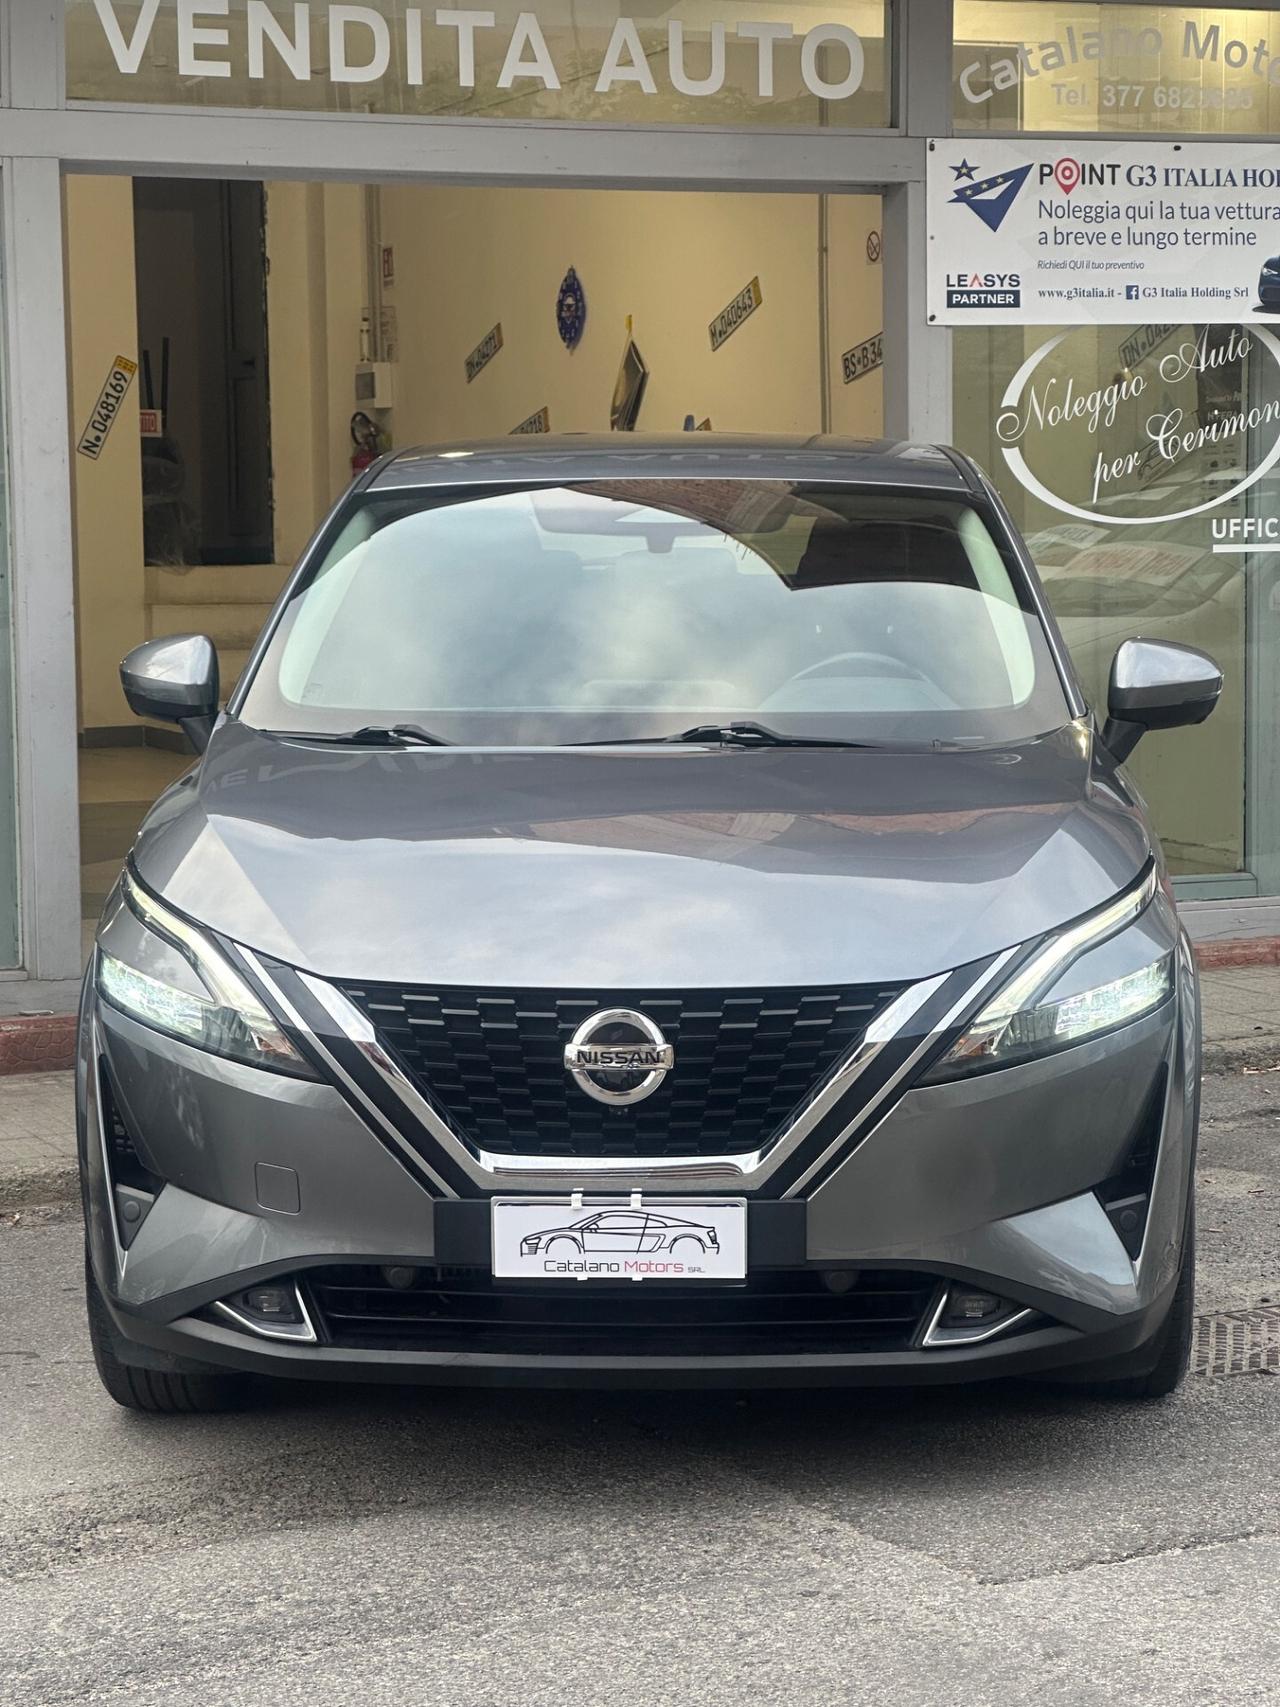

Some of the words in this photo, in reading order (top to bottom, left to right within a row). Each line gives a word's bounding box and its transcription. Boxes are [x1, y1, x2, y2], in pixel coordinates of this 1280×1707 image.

[89, 0, 562, 91] VENDITA
[594, 16, 865, 101] AUTO
[959, 25, 1164, 104] Catalano
[1103, 84, 1145, 108] 377
[1126, 164, 1157, 187] G3
[1164, 168, 1238, 187] ITALIA
[1038, 200, 1121, 223] Noleggia
[1126, 201, 1154, 223] qui
[1160, 201, 1175, 220] la
[1180, 205, 1210, 220] tua
[1215, 205, 1280, 221] vettura
[1038, 231, 1048, 245] a
[1054, 226, 1107, 246] breve
[1111, 231, 1122, 245] e
[1127, 227, 1179, 249] lungo
[1184, 227, 1257, 246] termine
[1037, 260, 1068, 270] Richiedi
[1068, 260, 1085, 270] QUI
[1085, 260, 1091, 269] il
[1091, 261, 1104, 270] tuo
[1105, 260, 1145, 271] preventivo
[946, 274, 1020, 288] LEASYS
[952, 294, 1014, 304] PARTNER
[1038, 287, 1115, 300] www.g3italia.it
[1142, 287, 1158, 298] G3
[1161, 287, 1188, 297] Italia
[1191, 287, 1232, 300] Holding
[1233, 287, 1249, 297] Srl
[996, 375, 1147, 441] Noleggio
[1160, 325, 1254, 383] Auto
[1091, 452, 1141, 504] per
[1212, 517, 1279, 539] UFFIC
[576, 1050, 662, 1064] NISSAN
[543, 1260, 620, 1273] Catalano
[624, 1260, 684, 1273] Motors
